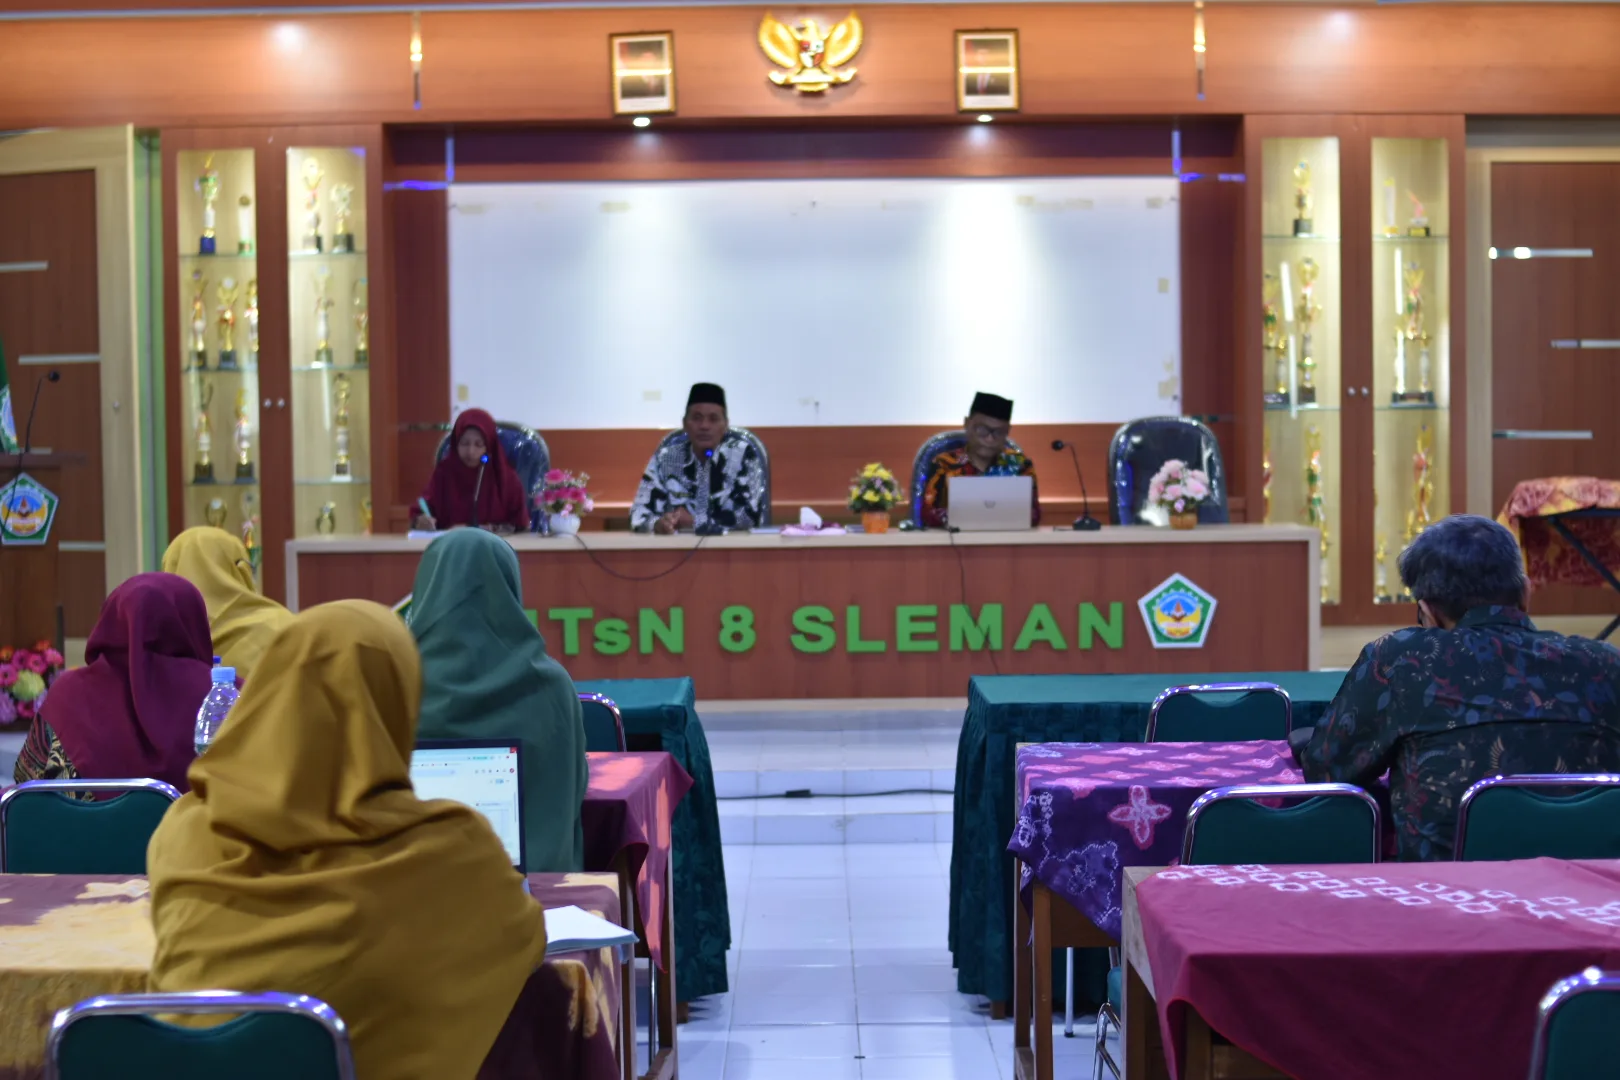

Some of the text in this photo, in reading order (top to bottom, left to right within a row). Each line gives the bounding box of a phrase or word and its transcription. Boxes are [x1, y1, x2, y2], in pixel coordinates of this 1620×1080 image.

[523, 601, 1125, 656] TsN 8 SLEMAN
